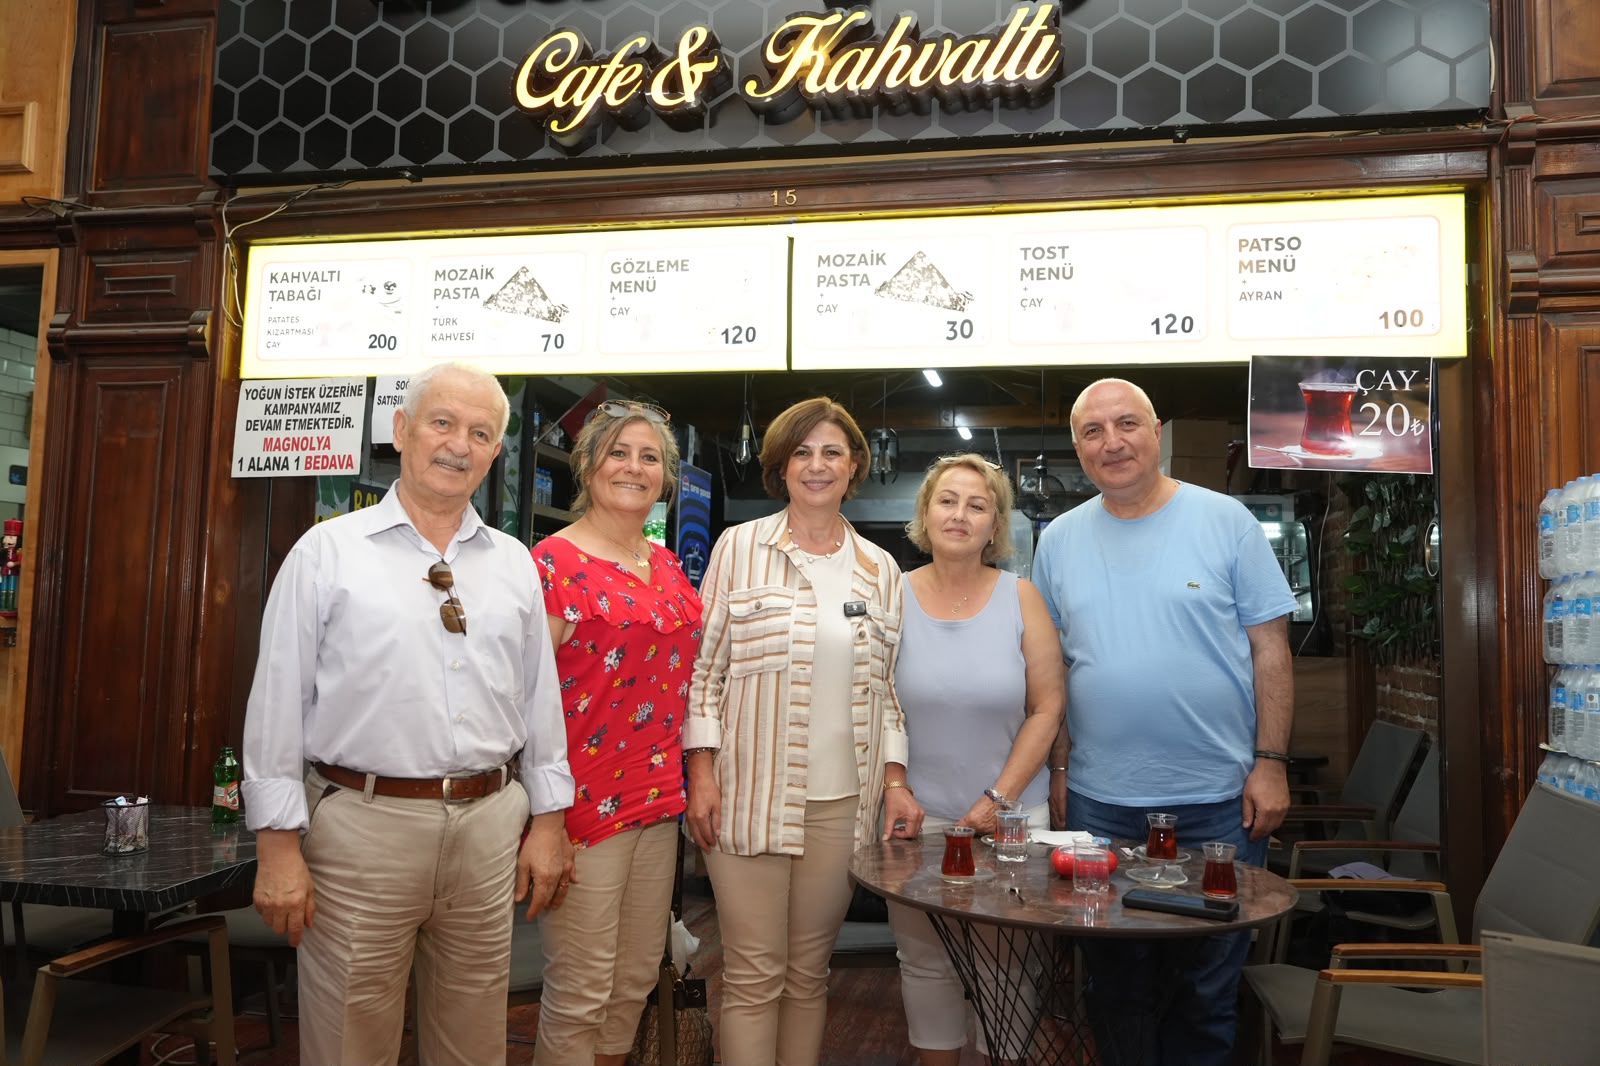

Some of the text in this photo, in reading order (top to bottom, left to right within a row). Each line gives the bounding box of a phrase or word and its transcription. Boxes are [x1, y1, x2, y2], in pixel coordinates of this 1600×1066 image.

[514, 4, 1060, 133] Cafe & Kahvaltı
[770, 188, 797, 206] 15
[1020, 246, 1070, 261] TOST
[1238, 236, 1302, 253] PATSO
[610, 257, 690, 275] GÖZLEME
[817, 249, 887, 268] MOZAİK
[1238, 254, 1297, 274] MENÜ
[269, 270, 341, 284] KAHVALTI
[434, 264, 495, 282] MOZAİK
[816, 273, 871, 288] PASTA
[1020, 262, 1074, 281] MENÜ
[268, 286, 322, 302] TABAĞI
[433, 287, 481, 301] PASTA
[609, 276, 657, 294] MENÜ
[1020, 297, 1044, 311] ÇAY
[1239, 290, 1283, 302] AYRAN
[610, 306, 631, 319] ÇAY
[816, 303, 839, 317] ÇAY
[267, 315, 301, 324] PATATES
[1150, 313, 1194, 335] 120
[1378, 309, 1424, 330] 100
[266, 327, 315, 337] KIZARTMASI
[431, 330, 475, 342] KAHVESİ
[720, 325, 757, 344] 120
[945, 318, 974, 341] 30
[367, 333, 397, 351] 200
[541, 333, 565, 353] 70
[244, 383, 364, 400] YOĞUN İSTEK ÜZERİNE
[1355, 369, 1420, 396] ÇAY
[264, 401, 341, 416] KAMPANYAMIZ
[245, 414, 355, 432] DEVAM ETMEKTEDİR.
[262, 435, 332, 452] MAGNOLYA
[237, 454, 355, 472] 1 ALANA 1 BEDAVA
